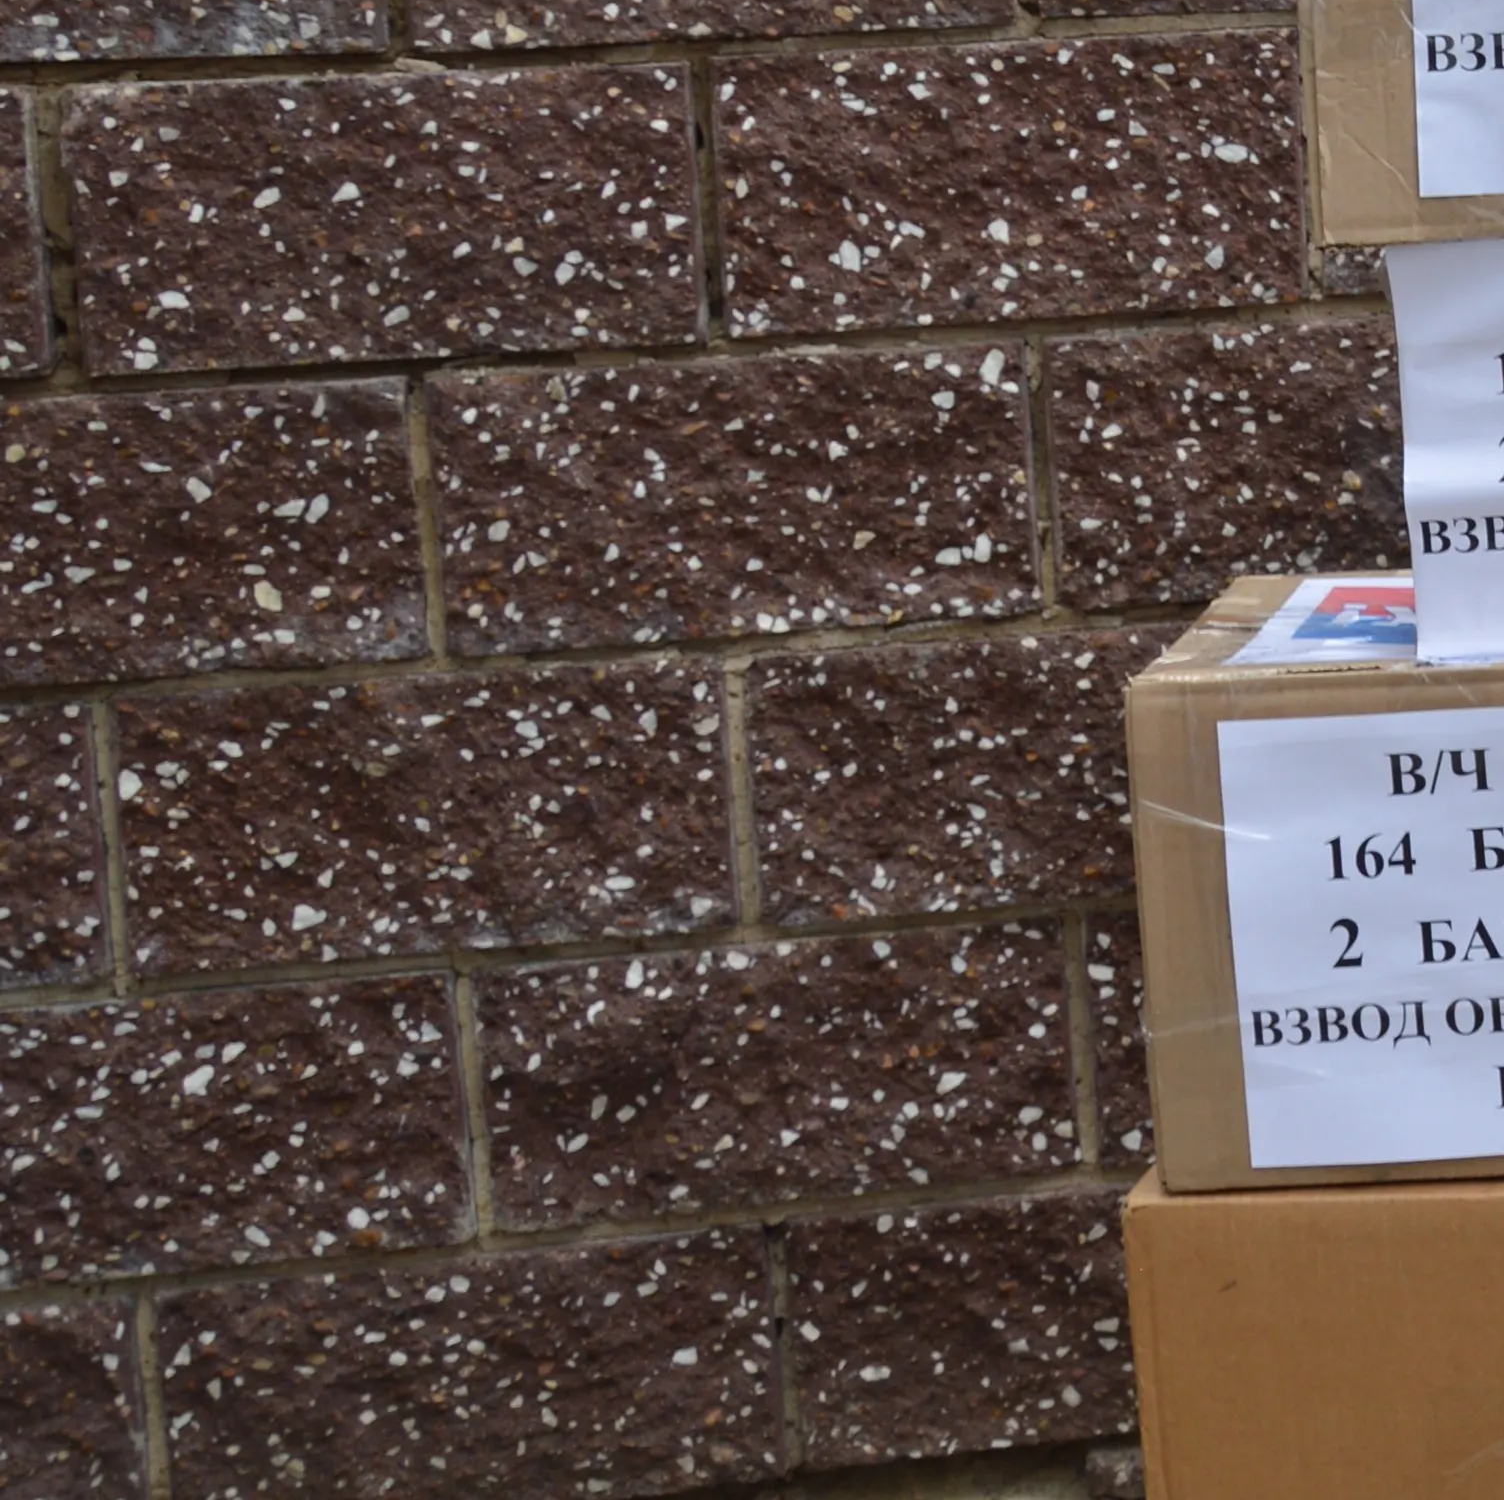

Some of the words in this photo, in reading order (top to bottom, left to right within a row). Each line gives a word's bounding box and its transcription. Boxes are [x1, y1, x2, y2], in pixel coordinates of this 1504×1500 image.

[1387, 747, 1490, 797] В/Ч
[1327, 830, 1418, 881] 164
[1329, 917, 1364, 970] 2
[1251, 1000, 1432, 1048] ВЗВОД
